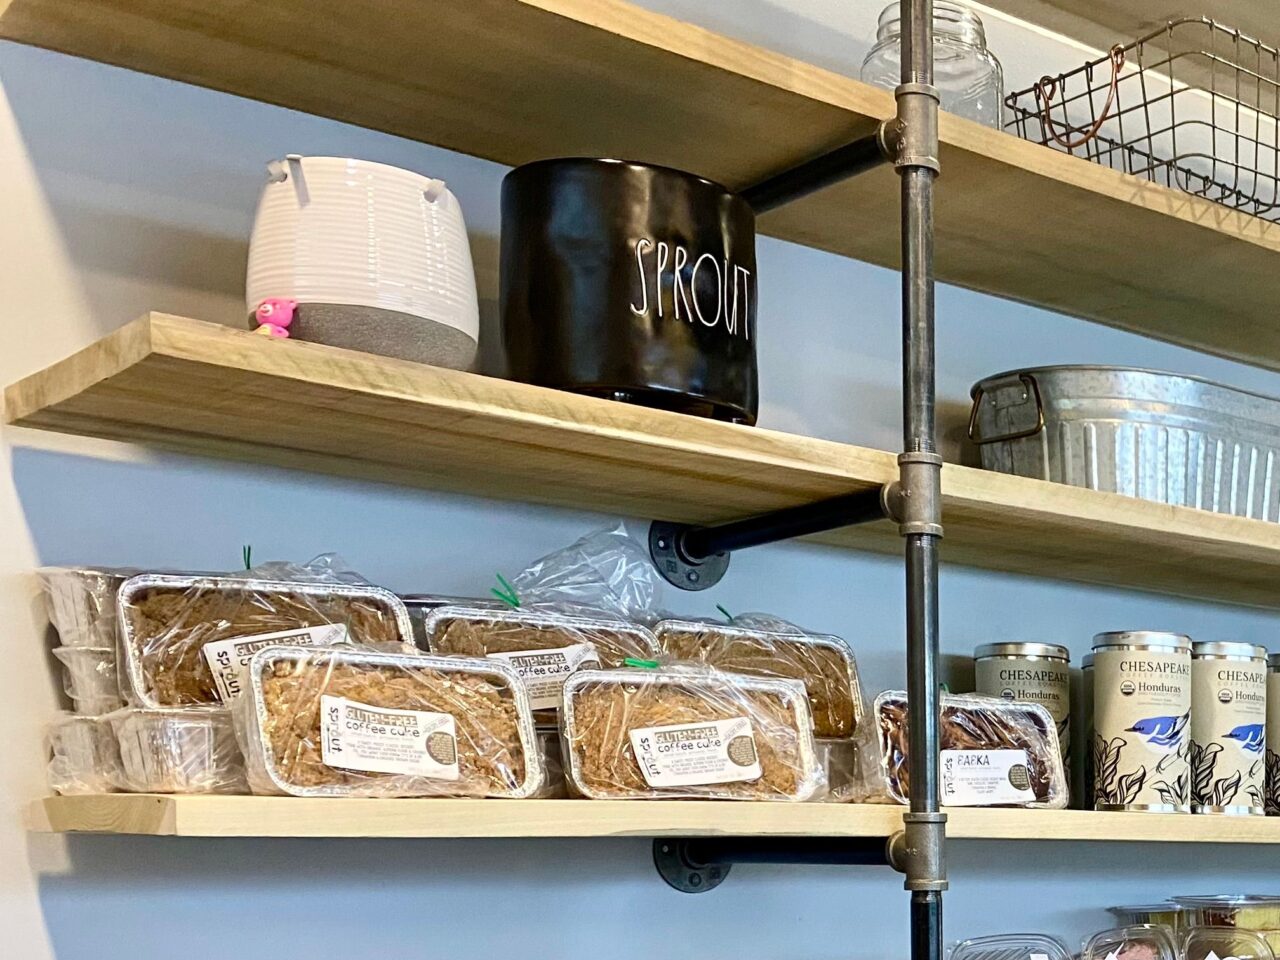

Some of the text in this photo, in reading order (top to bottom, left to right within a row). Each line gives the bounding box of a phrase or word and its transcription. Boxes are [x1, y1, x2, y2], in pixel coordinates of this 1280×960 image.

[630, 239, 750, 341] SPROUT
[509, 652, 567, 668] GLUTEN-FREE
[518, 663, 571, 677] offee cake
[1120, 661, 1191, 676] CHESAPEAKE
[1017, 688, 1061, 701] Honduras
[1138, 682, 1182, 693] Honduras
[345, 705, 418, 727] GLUTEN-FREE
[345, 719, 420, 738] coffee cake
[655, 726, 719, 744] GLUTEN-FREE
[658, 738, 722, 753] coffee cake
[957, 754, 990, 766] BABKA
